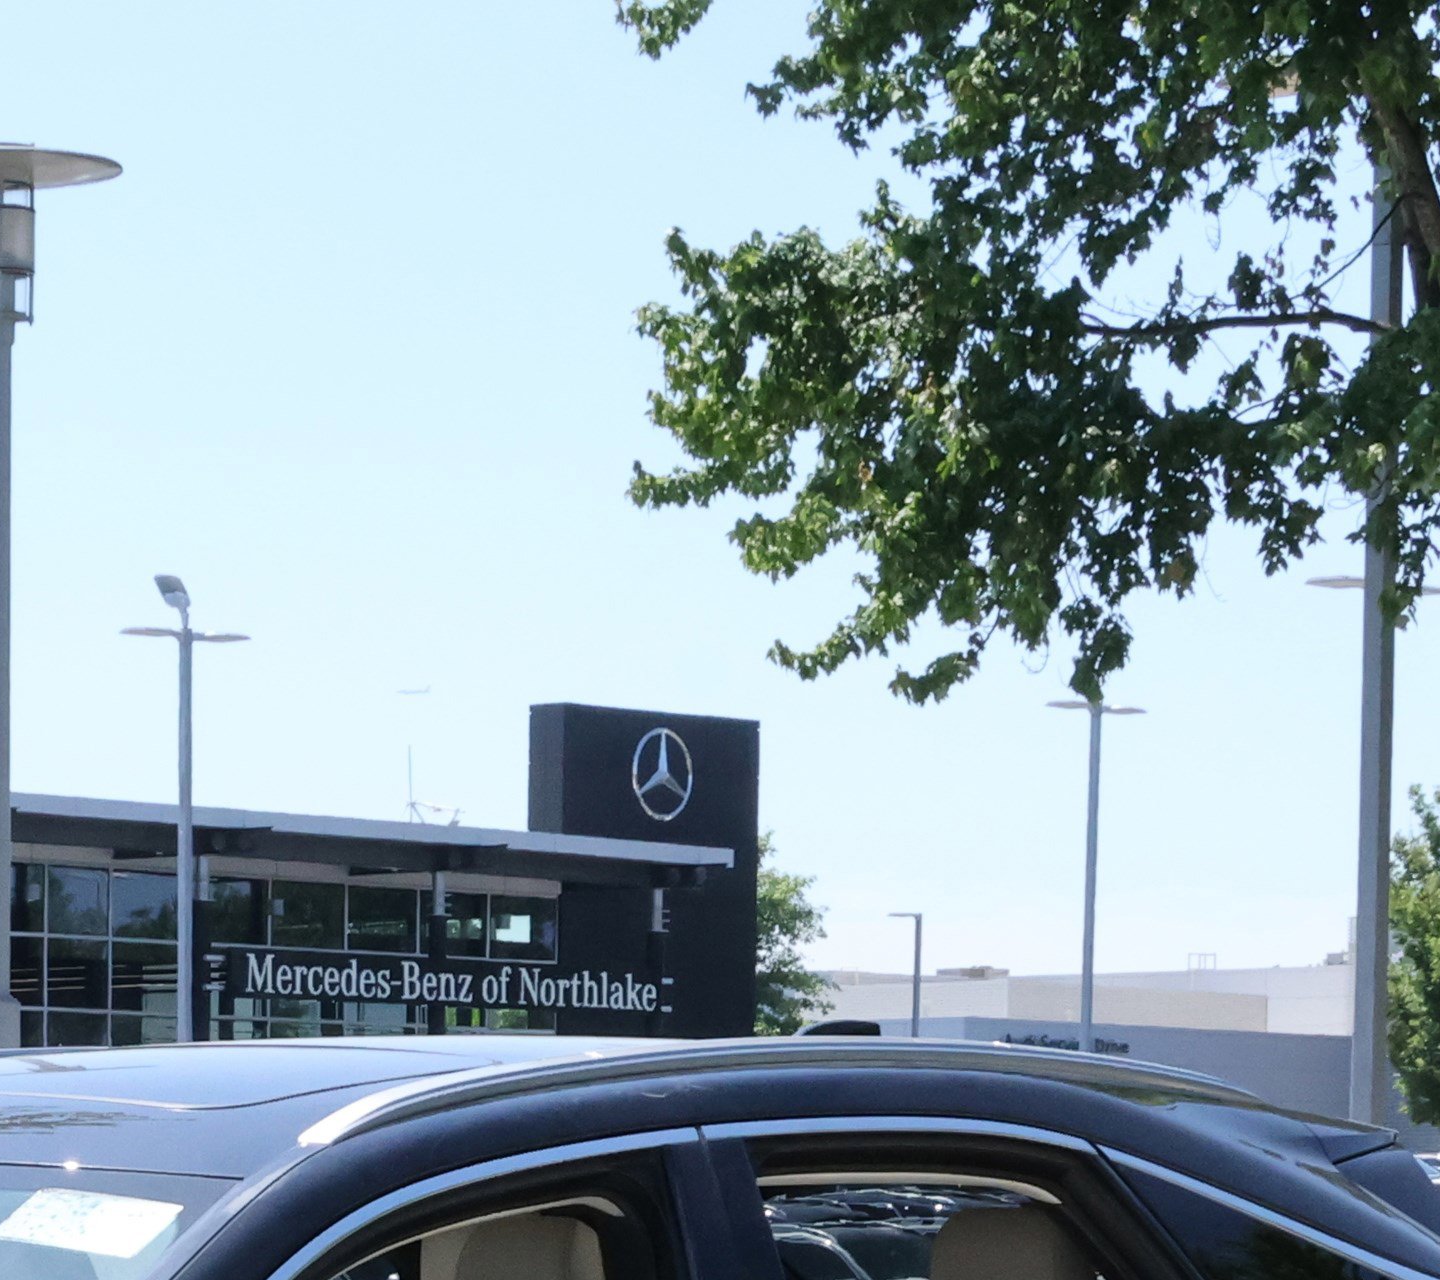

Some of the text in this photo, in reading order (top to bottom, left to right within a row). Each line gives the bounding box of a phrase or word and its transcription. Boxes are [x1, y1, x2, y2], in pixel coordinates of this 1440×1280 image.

[246, 953, 658, 1013] Mercedes-Benz of Northlake
